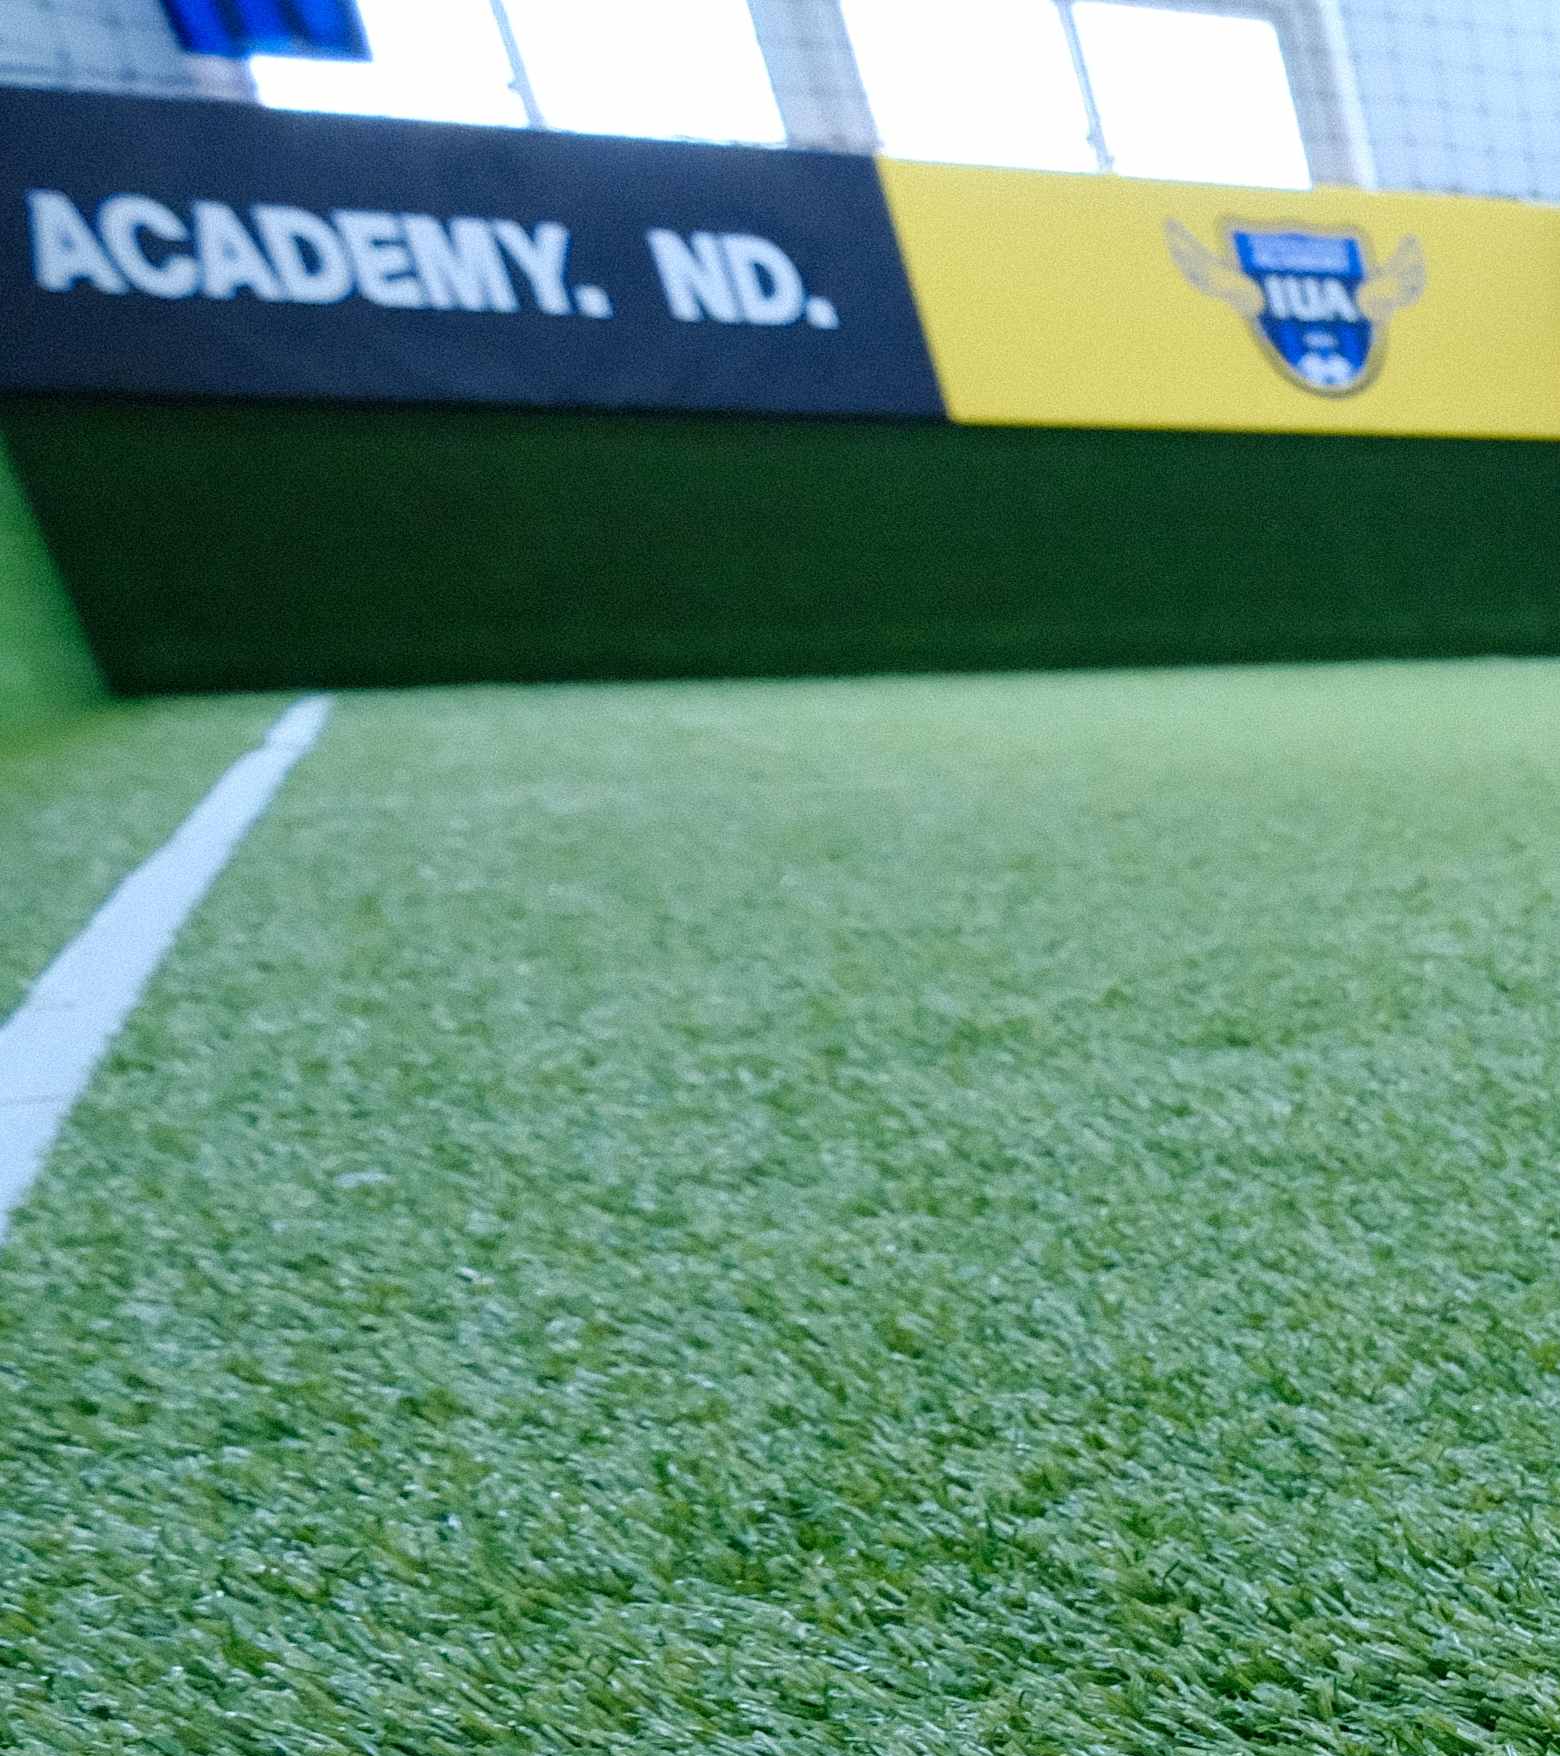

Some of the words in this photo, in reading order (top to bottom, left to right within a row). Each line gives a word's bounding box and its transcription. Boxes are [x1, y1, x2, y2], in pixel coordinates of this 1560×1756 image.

[25, 188, 614, 318] ACADEMY.
[647, 228, 841, 330] ND.
[1264, 275, 1360, 323] IUA
